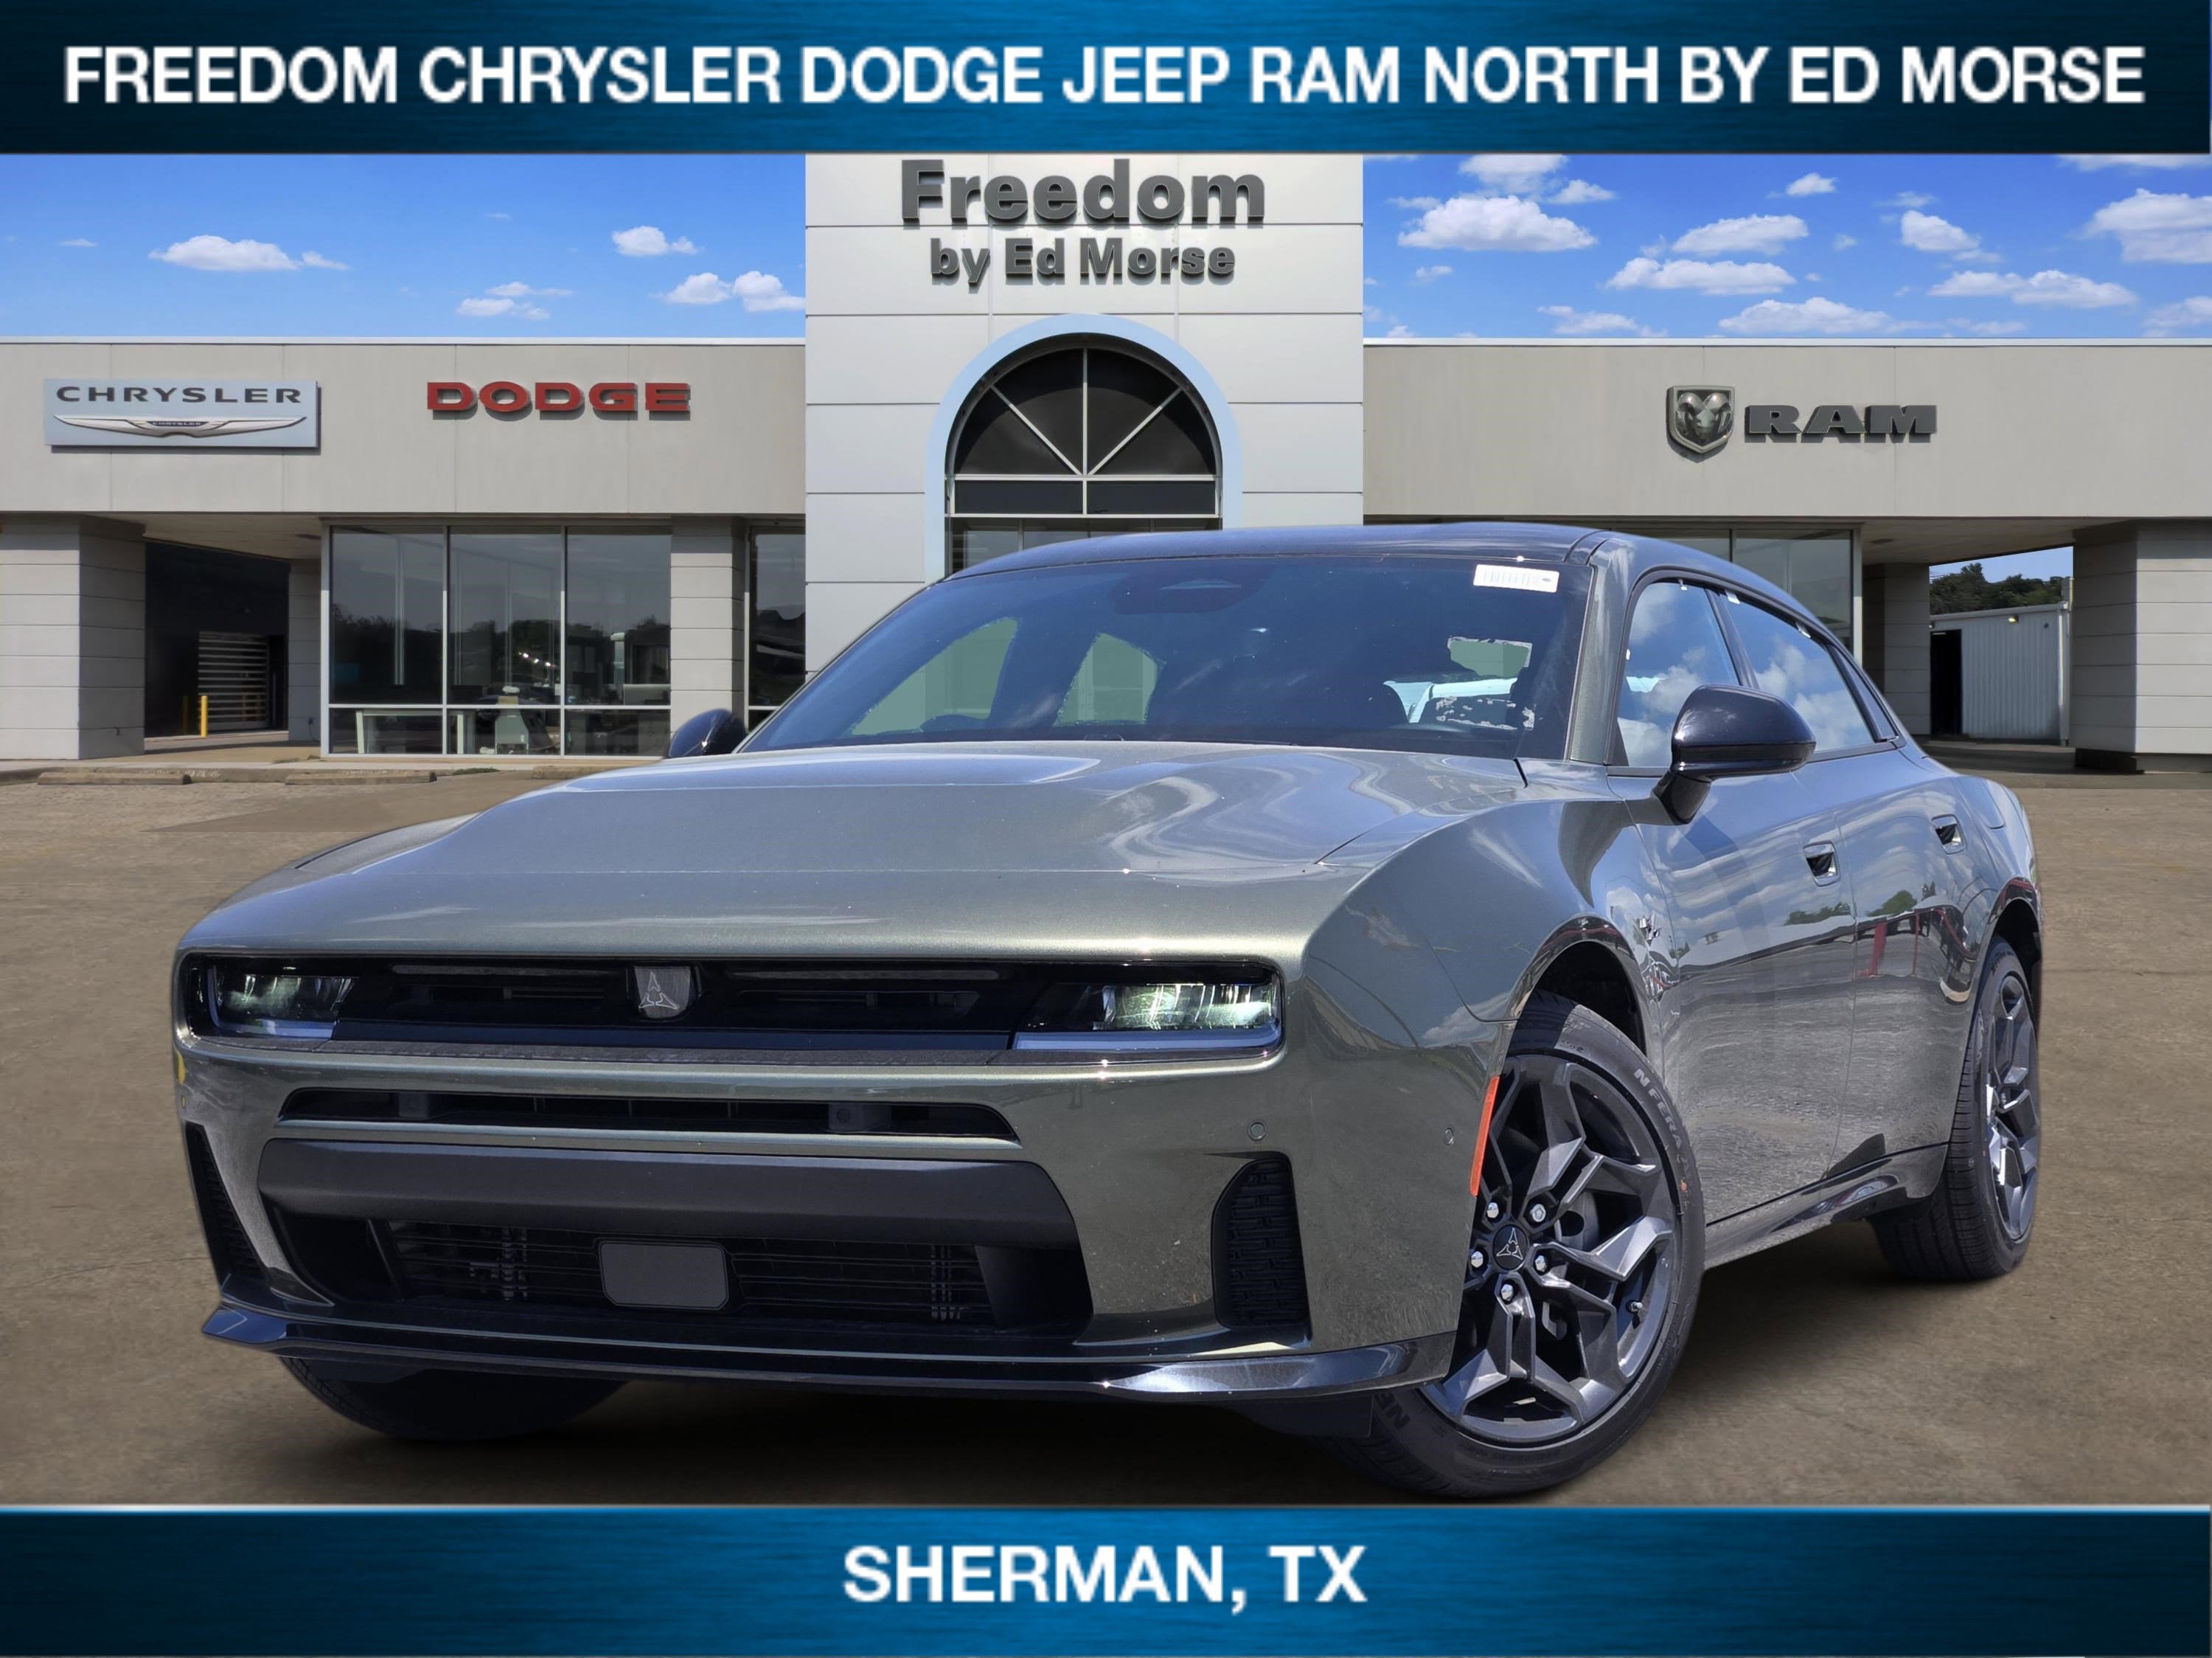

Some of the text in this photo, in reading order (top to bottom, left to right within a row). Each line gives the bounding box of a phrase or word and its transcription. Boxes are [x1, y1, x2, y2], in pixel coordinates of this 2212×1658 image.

[901, 159, 1265, 224] Freedom
[931, 237, 1236, 285] by Ed Morse
[56, 386, 302, 403] CHRYSLER
[427, 381, 690, 412] DODGE
[1745, 405, 1938, 434] RAM
